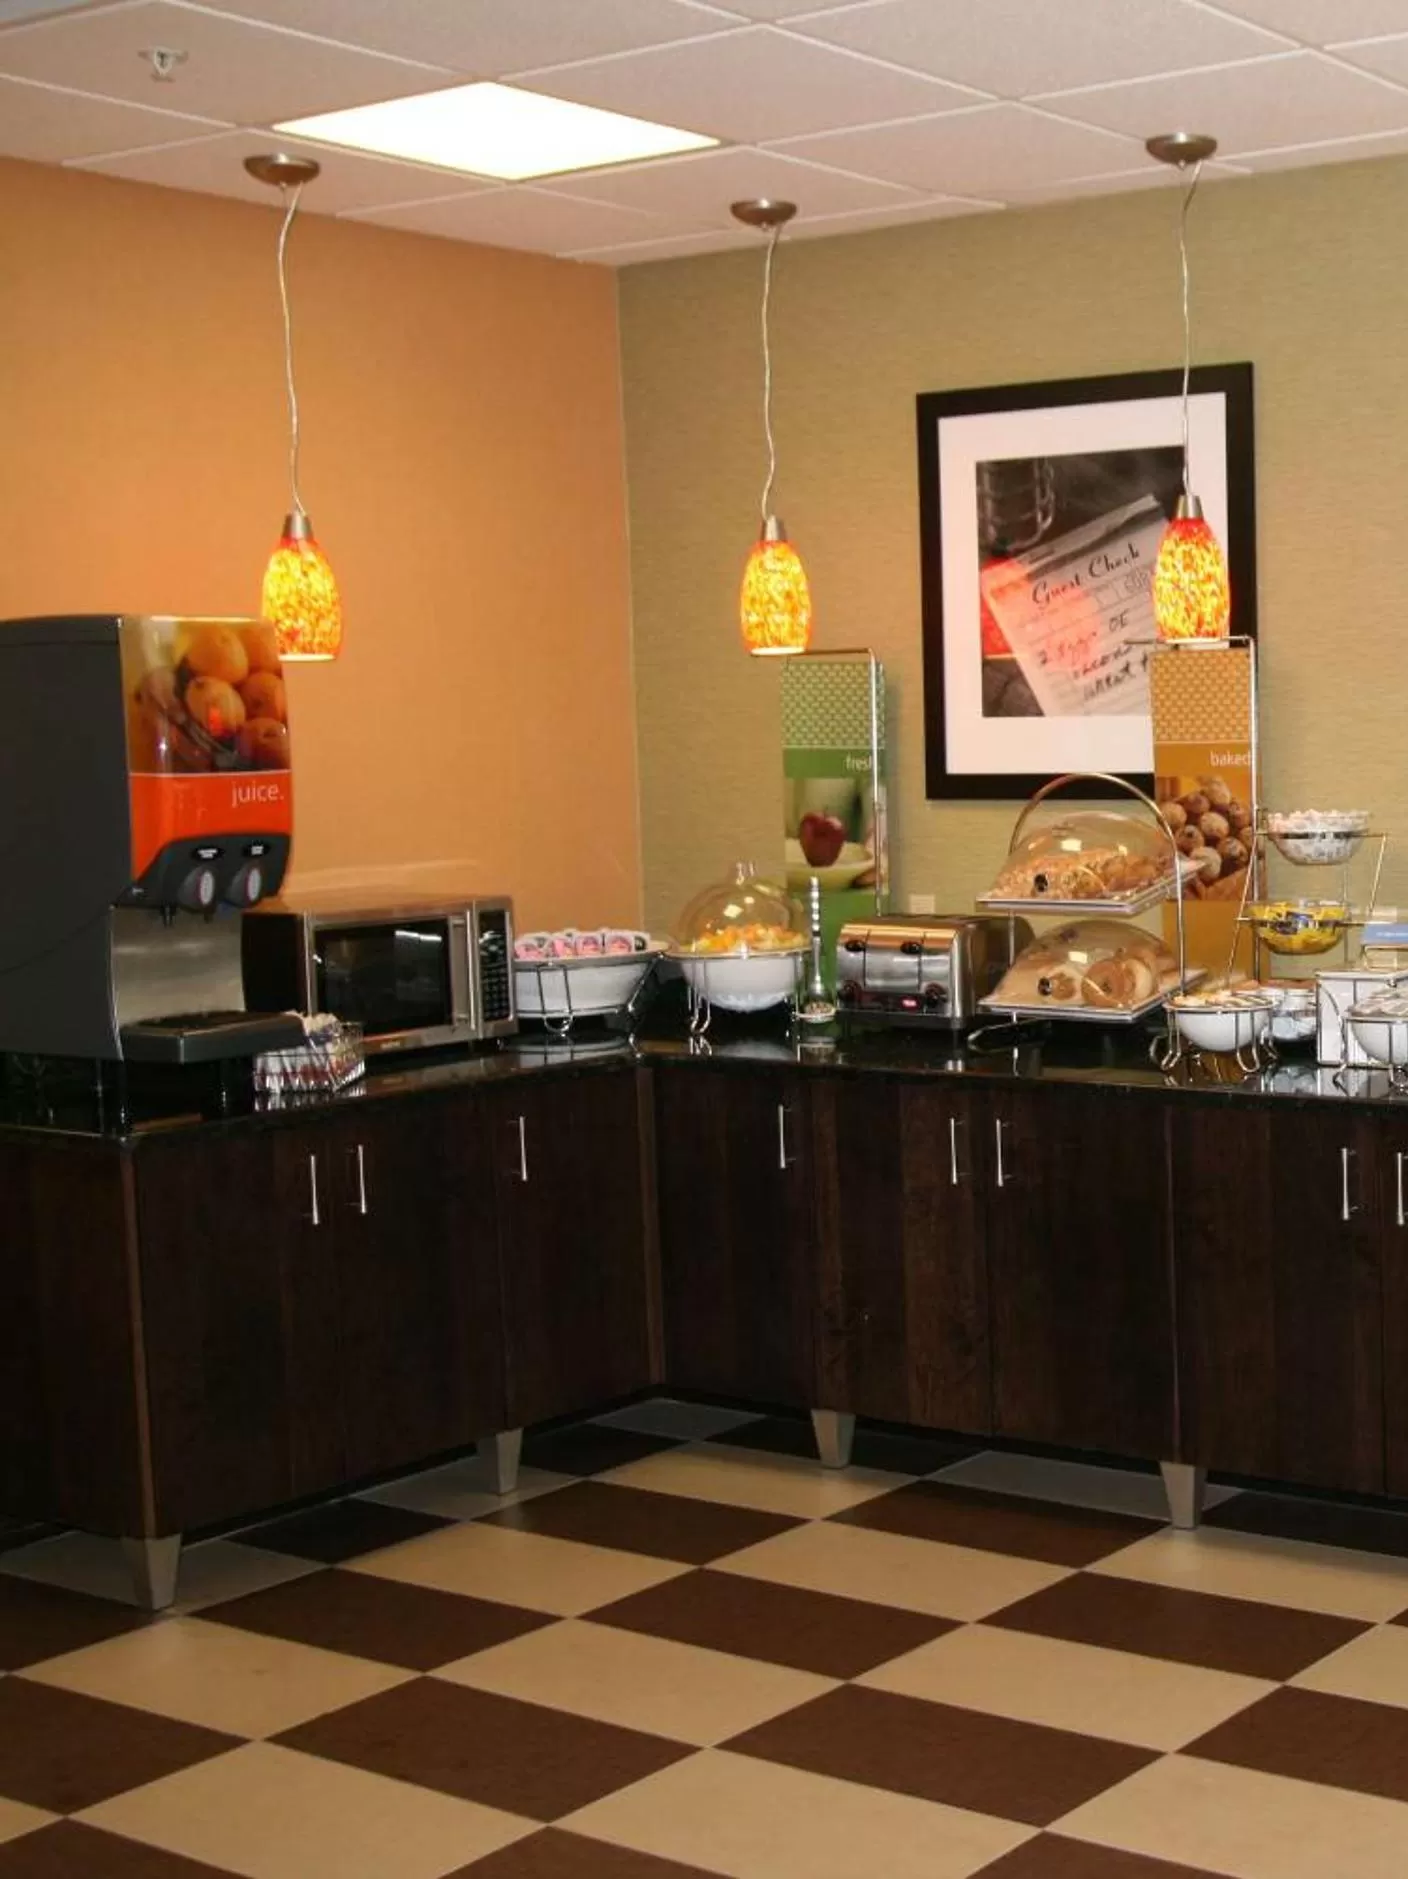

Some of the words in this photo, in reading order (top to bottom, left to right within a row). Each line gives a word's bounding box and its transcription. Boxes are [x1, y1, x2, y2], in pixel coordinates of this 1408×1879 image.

[1031, 572, 1081, 610] Guest
[1087, 541, 1140, 578] Check
[231, 780, 285, 809] juice.
